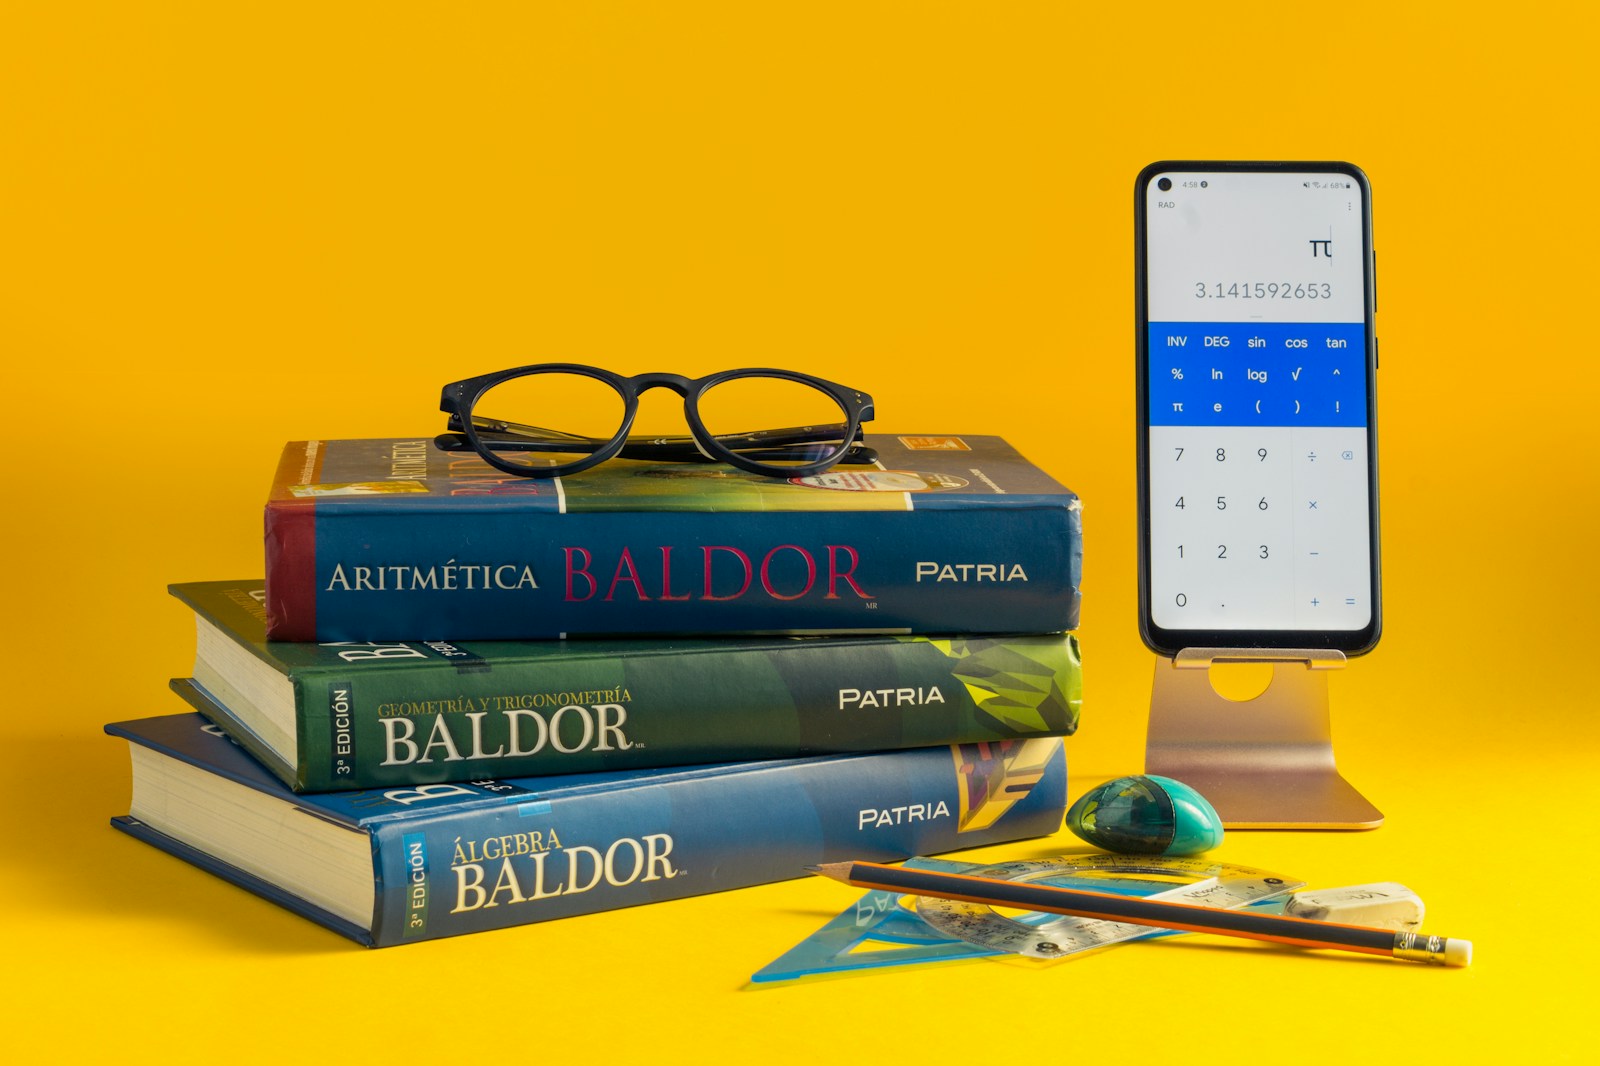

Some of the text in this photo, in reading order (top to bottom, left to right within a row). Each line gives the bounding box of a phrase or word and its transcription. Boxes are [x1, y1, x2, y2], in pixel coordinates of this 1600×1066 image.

[1182, 181, 1198, 189] 4:58
[1158, 201, 1175, 209] RAD
[1195, 282, 1332, 299] 3.141592653
[1167, 336, 1347, 348] INV DEG sin cos tan
[1171, 368, 1184, 380] %
[1247, 368, 1268, 383] log
[1213, 402, 1222, 412] e
[1175, 448, 1184, 461] 7
[1216, 448, 1226, 462] 8
[1257, 448, 1267, 462] 9
[1175, 496, 1185, 509] 4
[1217, 496, 1227, 510] 5
[1258, 497, 1268, 510] 6
[1177, 545, 1184, 558] 1
[1217, 545, 1227, 559] 2
[1259, 545, 1269, 559] 3
[325, 544, 876, 602] ARITMÉTICA BALDOR
[916, 562, 1028, 583] PATRIA
[1175, 593, 1187, 607] 0
[377, 685, 632, 718] GEOMETRÍA Y TRIGONOMETRÍA
[839, 686, 945, 710] PATRIA
[331, 689, 351, 756] EDICIÓN
[378, 703, 635, 767] BALDOR
[858, 800, 950, 830] PATRIA
[451, 828, 563, 866] ÁLGEBRA
[410, 842, 426, 910] EDICIÓN
[450, 833, 679, 914] BALDOR
